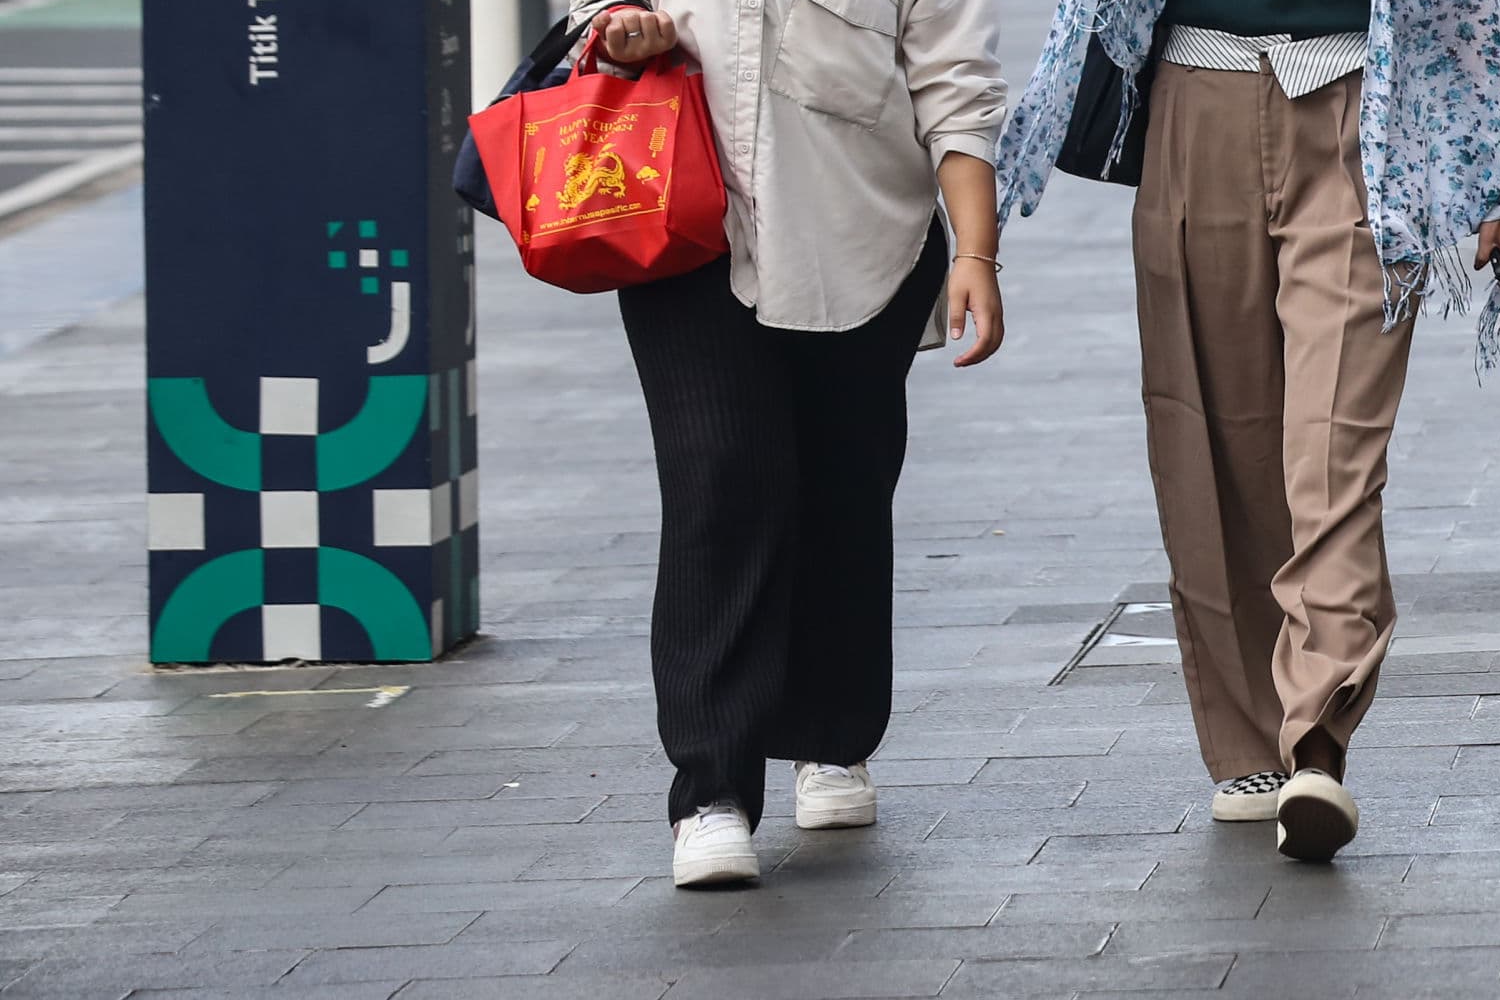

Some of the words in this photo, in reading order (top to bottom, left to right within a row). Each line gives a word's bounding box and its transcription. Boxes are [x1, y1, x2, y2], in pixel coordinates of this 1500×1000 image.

[248, 14, 279, 86] Titik
[559, 117, 591, 136] HAPPY
[559, 130, 579, 148] NEW
